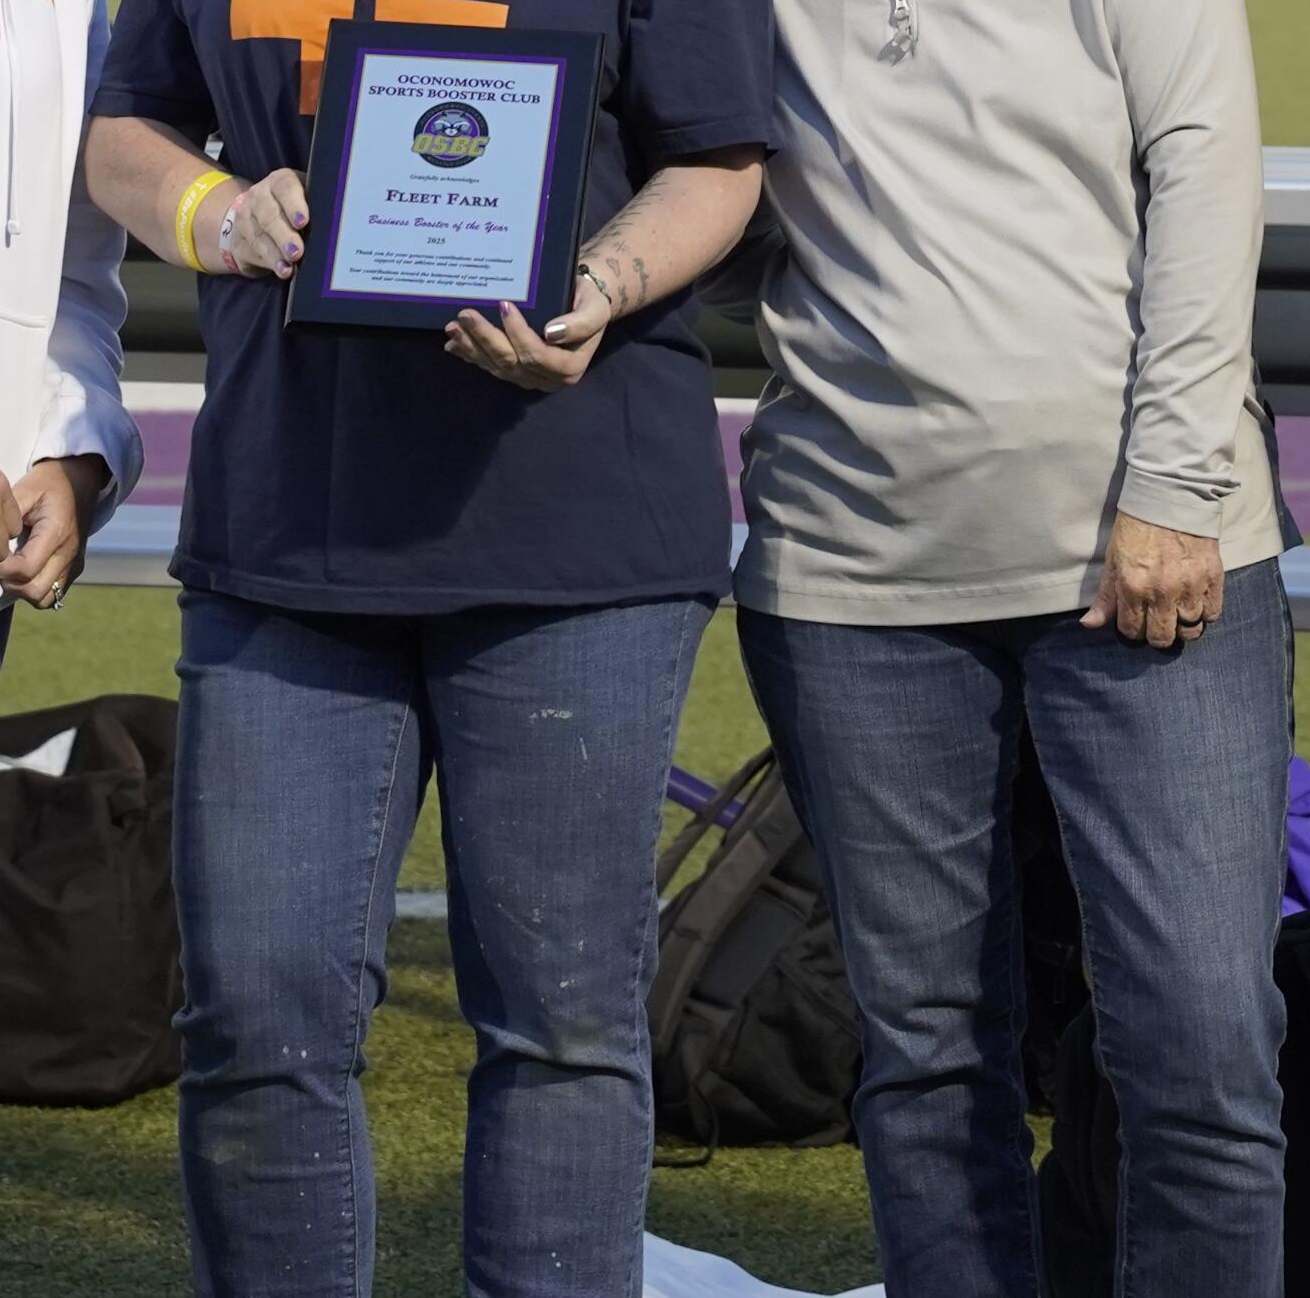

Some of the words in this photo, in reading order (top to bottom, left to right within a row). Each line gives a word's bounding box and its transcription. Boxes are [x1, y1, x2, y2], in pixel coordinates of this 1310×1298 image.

[397, 73, 516, 90] OCONOMOWOC
[368, 85, 424, 98] SPORTS
[427, 88, 497, 102] BOOSTER
[500, 92, 541, 104] CLUB
[411, 133, 491, 158] OSBC
[385, 189, 442, 204] FLEET
[446, 193, 500, 208] FARM
[368, 214, 410, 227] Business
[413, 217, 450, 230] Booster
[451, 221, 465, 233] of
[465, 220, 480, 232] the
[483, 221, 509, 234] Year
[427, 236, 446, 246] 2025
